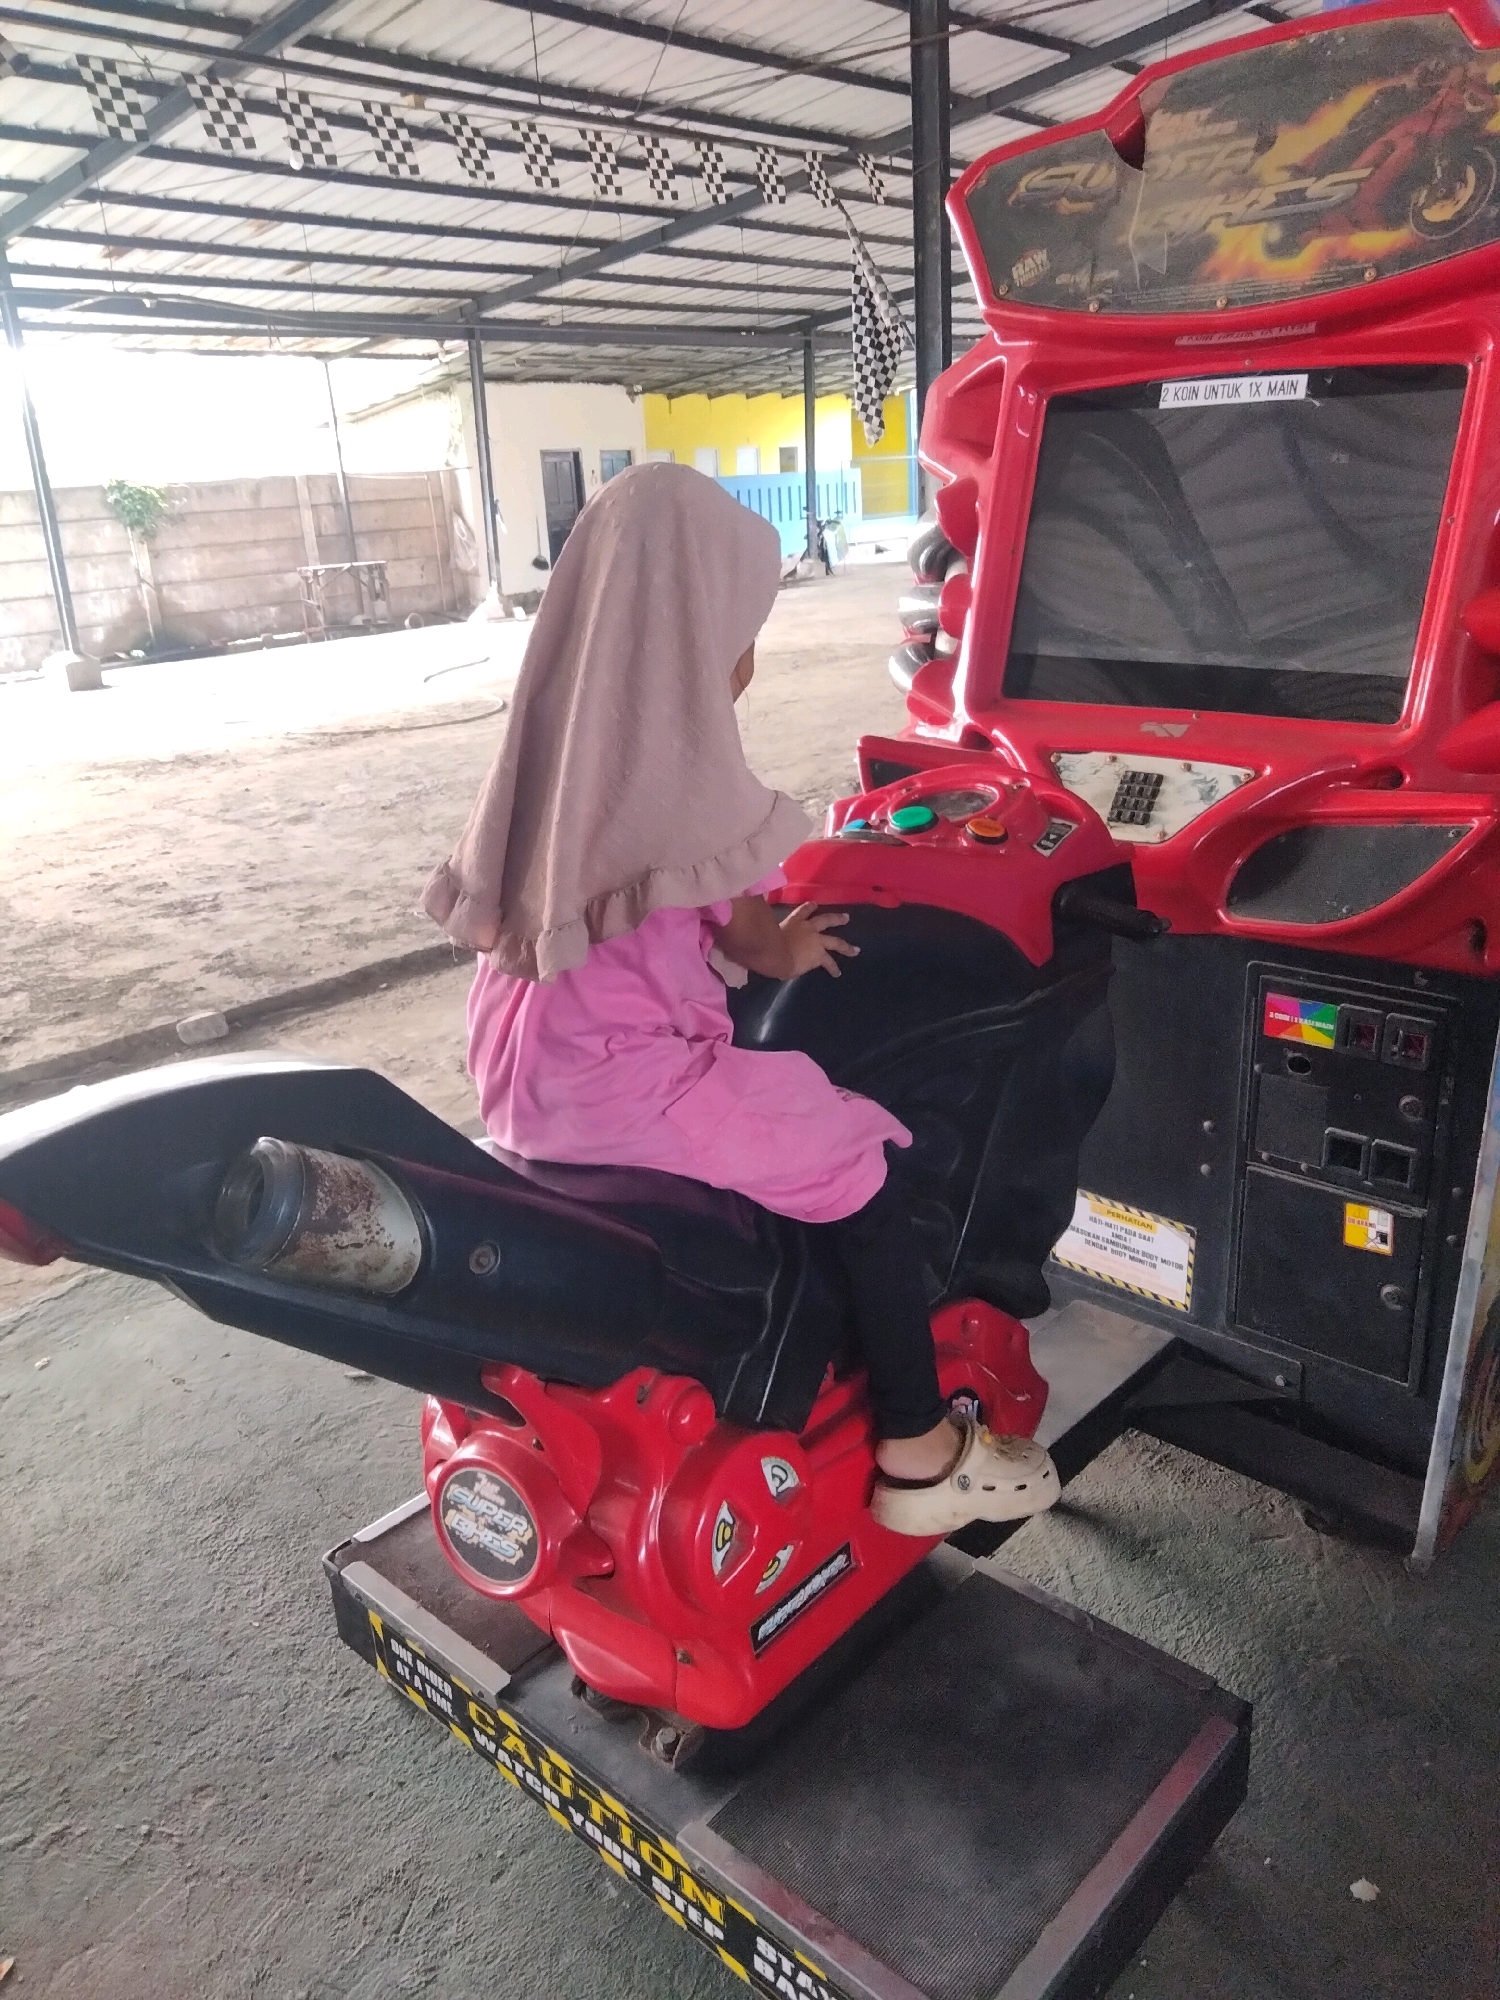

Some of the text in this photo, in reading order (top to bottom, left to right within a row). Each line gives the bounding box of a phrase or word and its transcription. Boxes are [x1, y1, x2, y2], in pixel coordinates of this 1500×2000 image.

[1161, 379, 1300, 403] 2 KOIN UNTUK 1X MAIN
[1088, 1215, 1155, 1243] HATI-HATI PADA SAAT
[1106, 1209, 1153, 1230] PERHATIAN
[1068, 1225, 1184, 1271] MASUKAN SAMBUNGAN BODY MOTOR
[1084, 1238, 1157, 1270] DENGAN BODY MONITOR
[450, 1486, 528, 1537] SUPER
[451, 1513, 519, 1558] BIKES
[390, 1638, 453, 1700] ONE RIDER
[396, 1660, 411, 1682] AT
[413, 1674, 423, 1691] A
[467, 1700, 726, 1926] CAUTION
[472, 1727, 725, 1941] WATCH YOUR STEP
